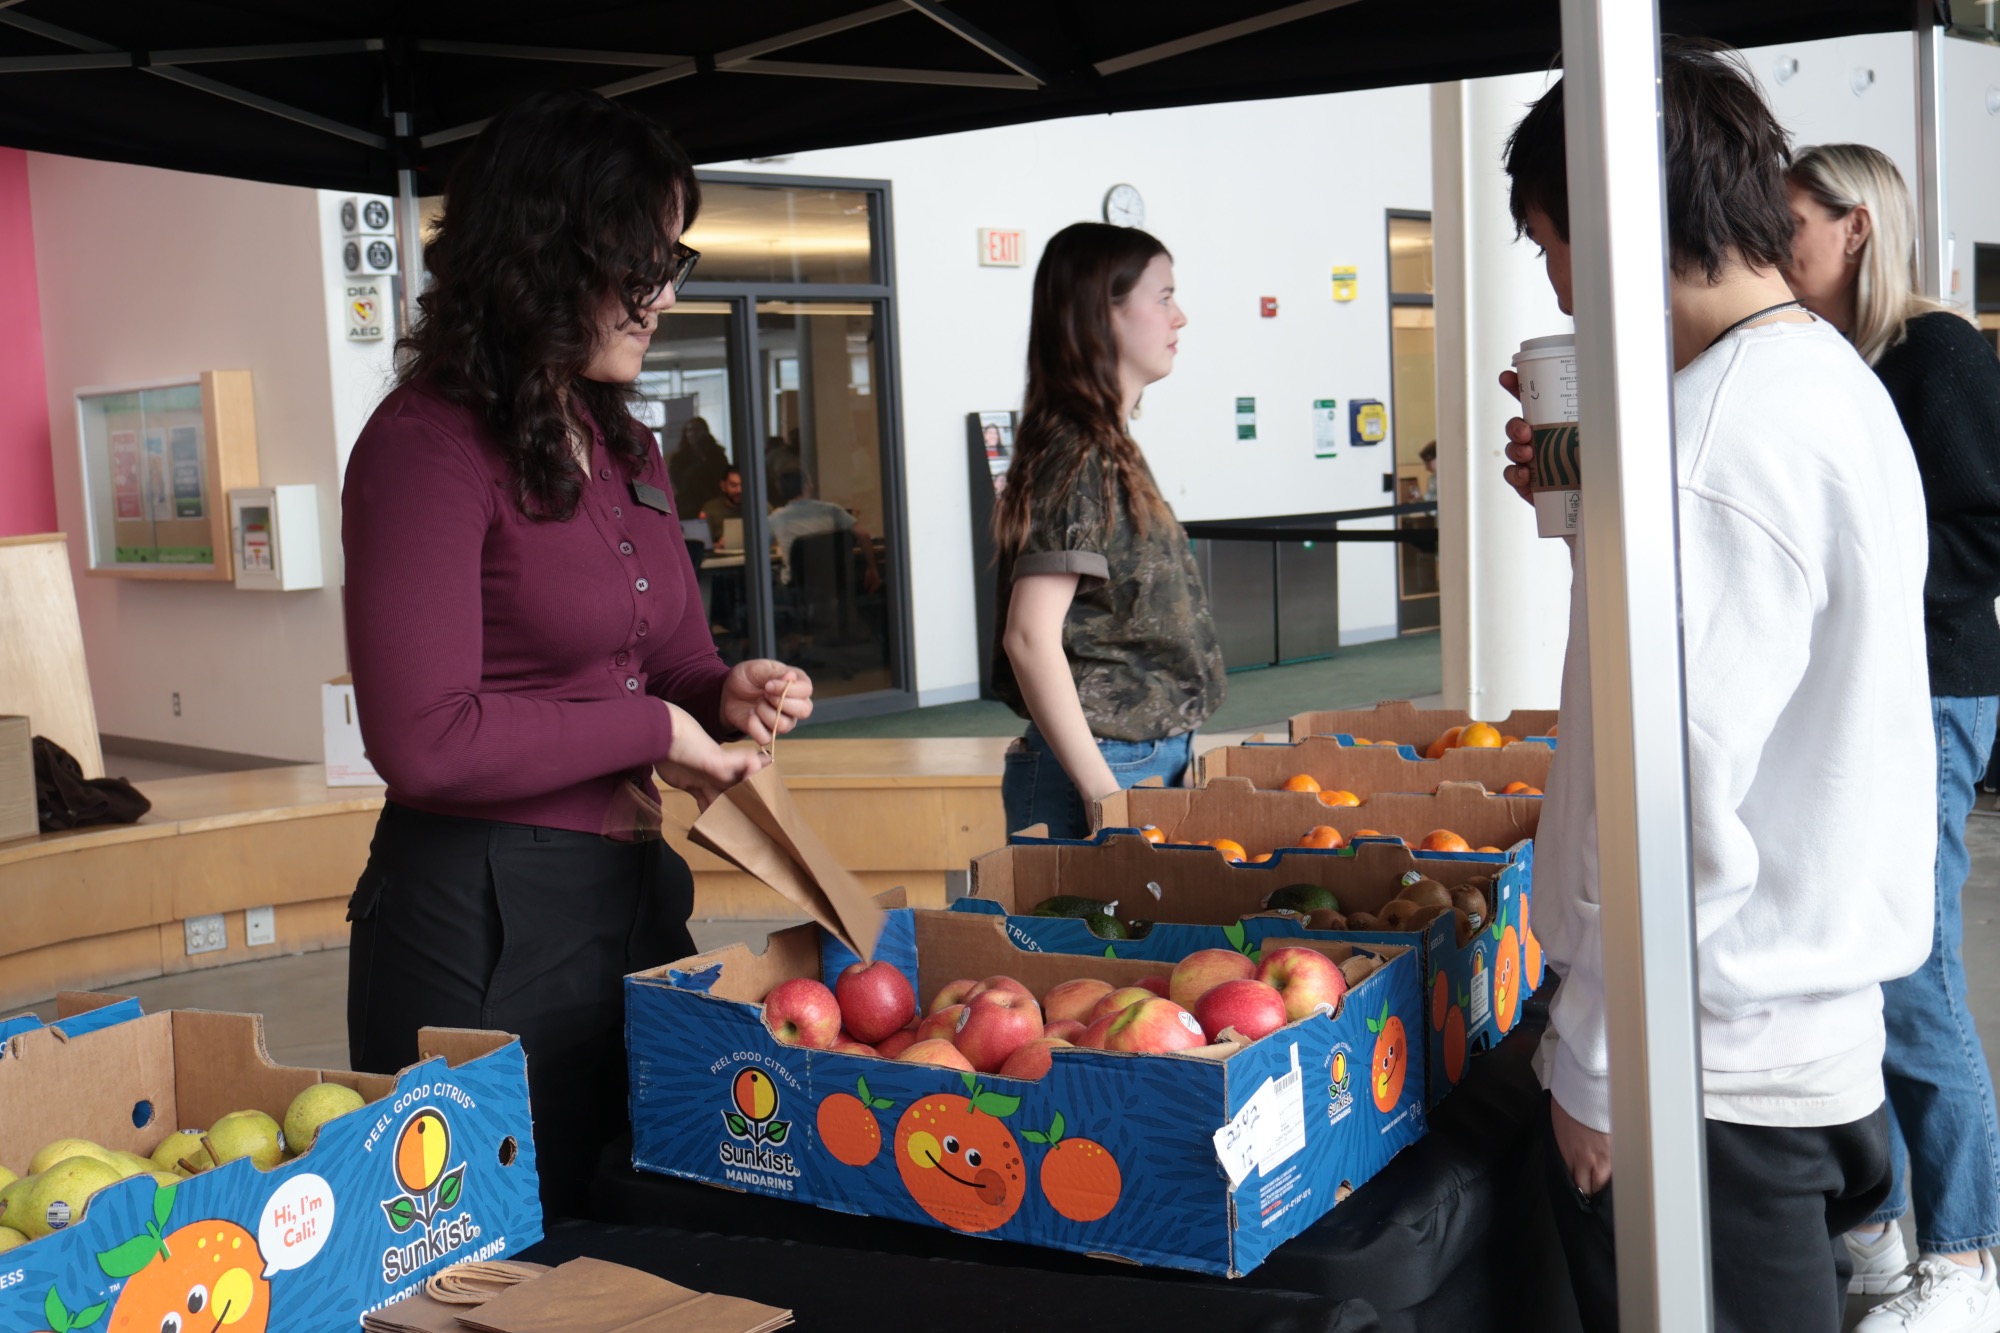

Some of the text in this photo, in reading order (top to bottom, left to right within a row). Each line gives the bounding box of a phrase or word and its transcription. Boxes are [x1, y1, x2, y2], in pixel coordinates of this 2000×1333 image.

[989, 231, 1020, 262] EXIT
[347, 286, 378, 297] DEA
[350, 327, 380, 337] AED
[710, 1055, 731, 1075] PEEL
[732, 1051, 762, 1062] GOOD
[364, 1113, 392, 1152] PEEL
[393, 1084, 430, 1114] GOOD
[726, 1168, 794, 1191] MANDARINS
[274, 1195, 322, 1228] Hi, I'm
[283, 1217, 316, 1247] Cali!
